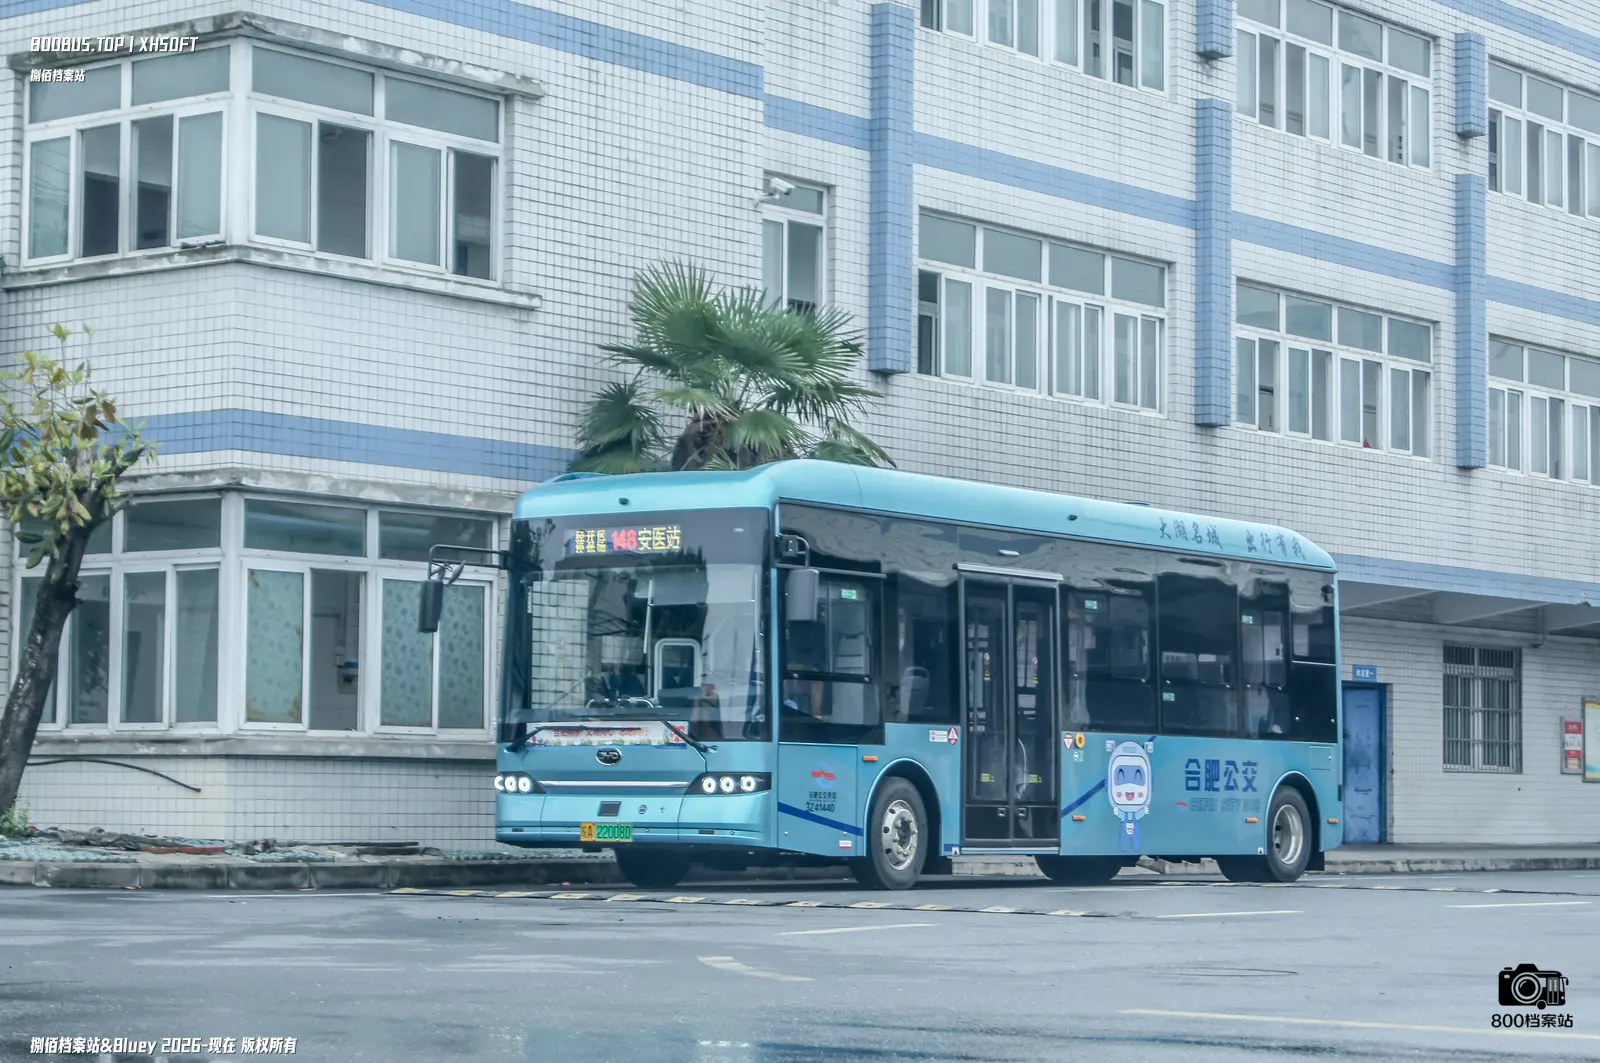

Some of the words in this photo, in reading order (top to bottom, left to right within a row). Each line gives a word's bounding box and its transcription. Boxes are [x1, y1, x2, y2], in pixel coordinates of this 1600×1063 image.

[611, 529, 638, 551] 148
[638, 525, 681, 551] 安医站
[1184, 758, 1258, 793] 合肥公交
